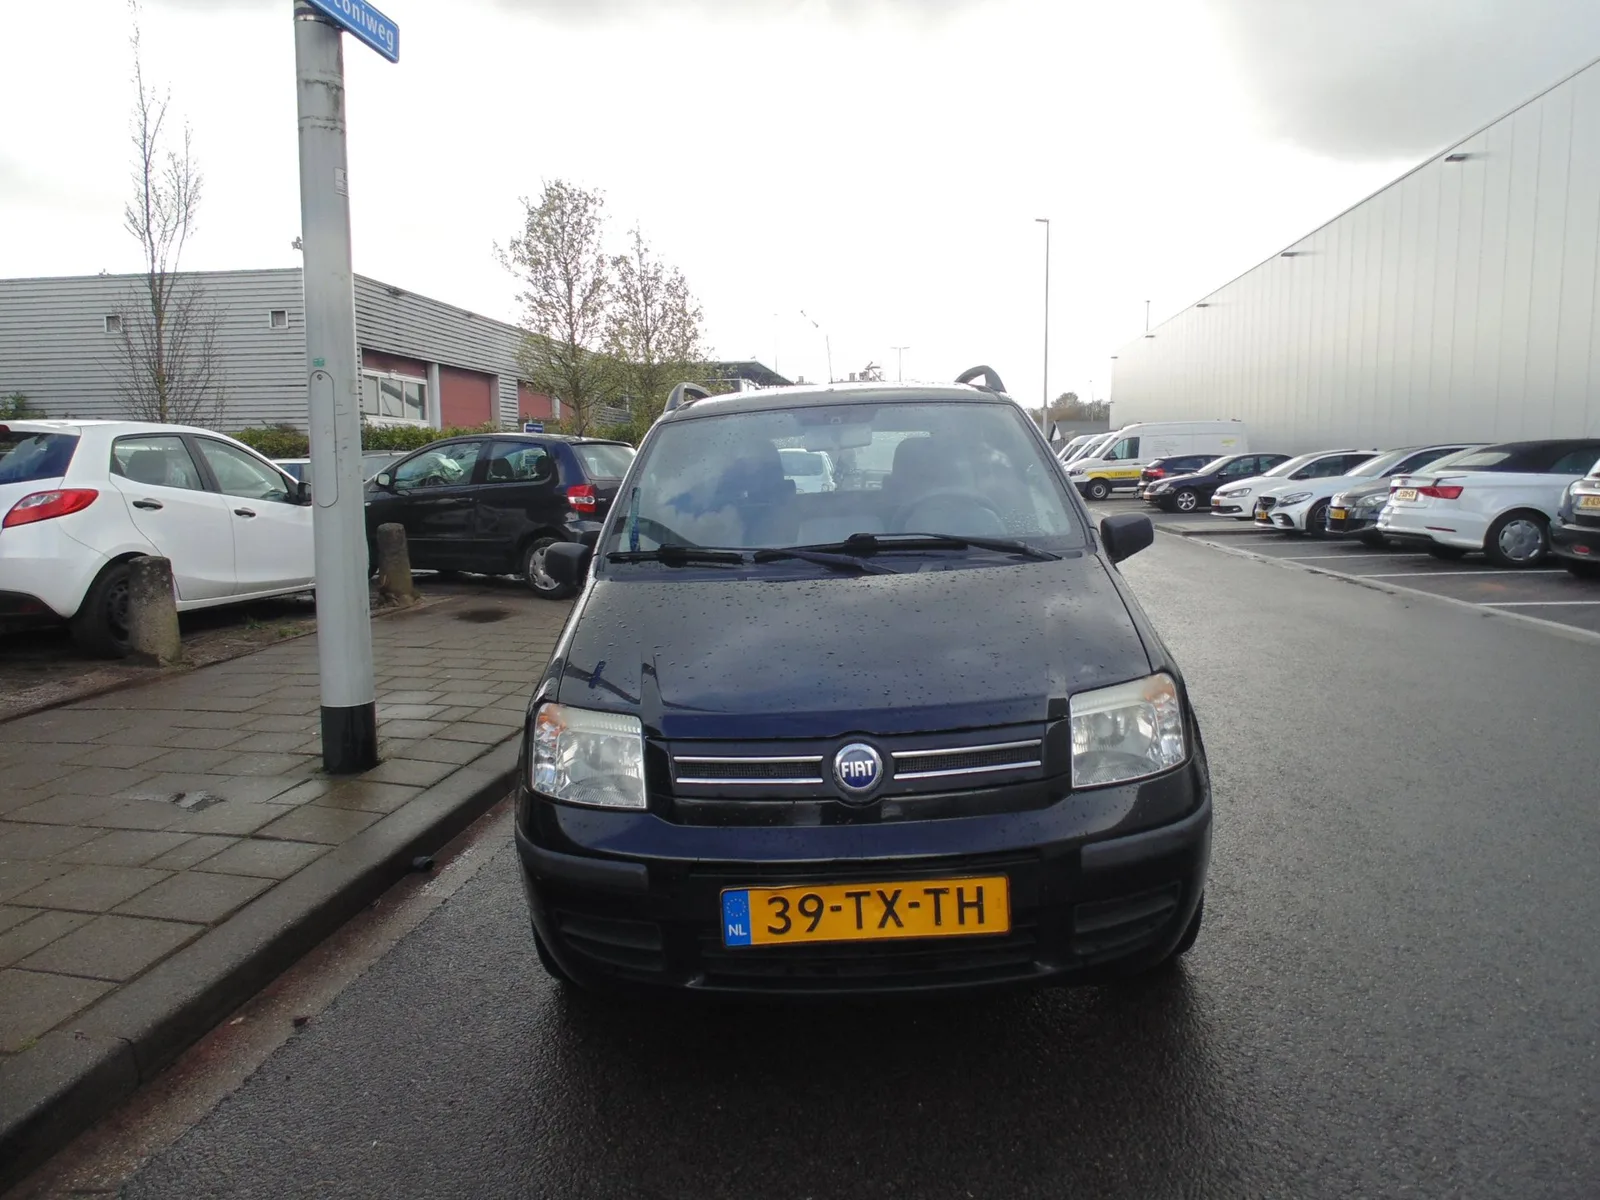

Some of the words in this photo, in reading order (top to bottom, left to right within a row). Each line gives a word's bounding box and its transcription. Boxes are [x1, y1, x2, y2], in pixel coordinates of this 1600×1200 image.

[841, 760, 874, 778] FIAT
[767, 885, 985, 935] 39-TX-TH
[728, 924, 747, 937] NL
